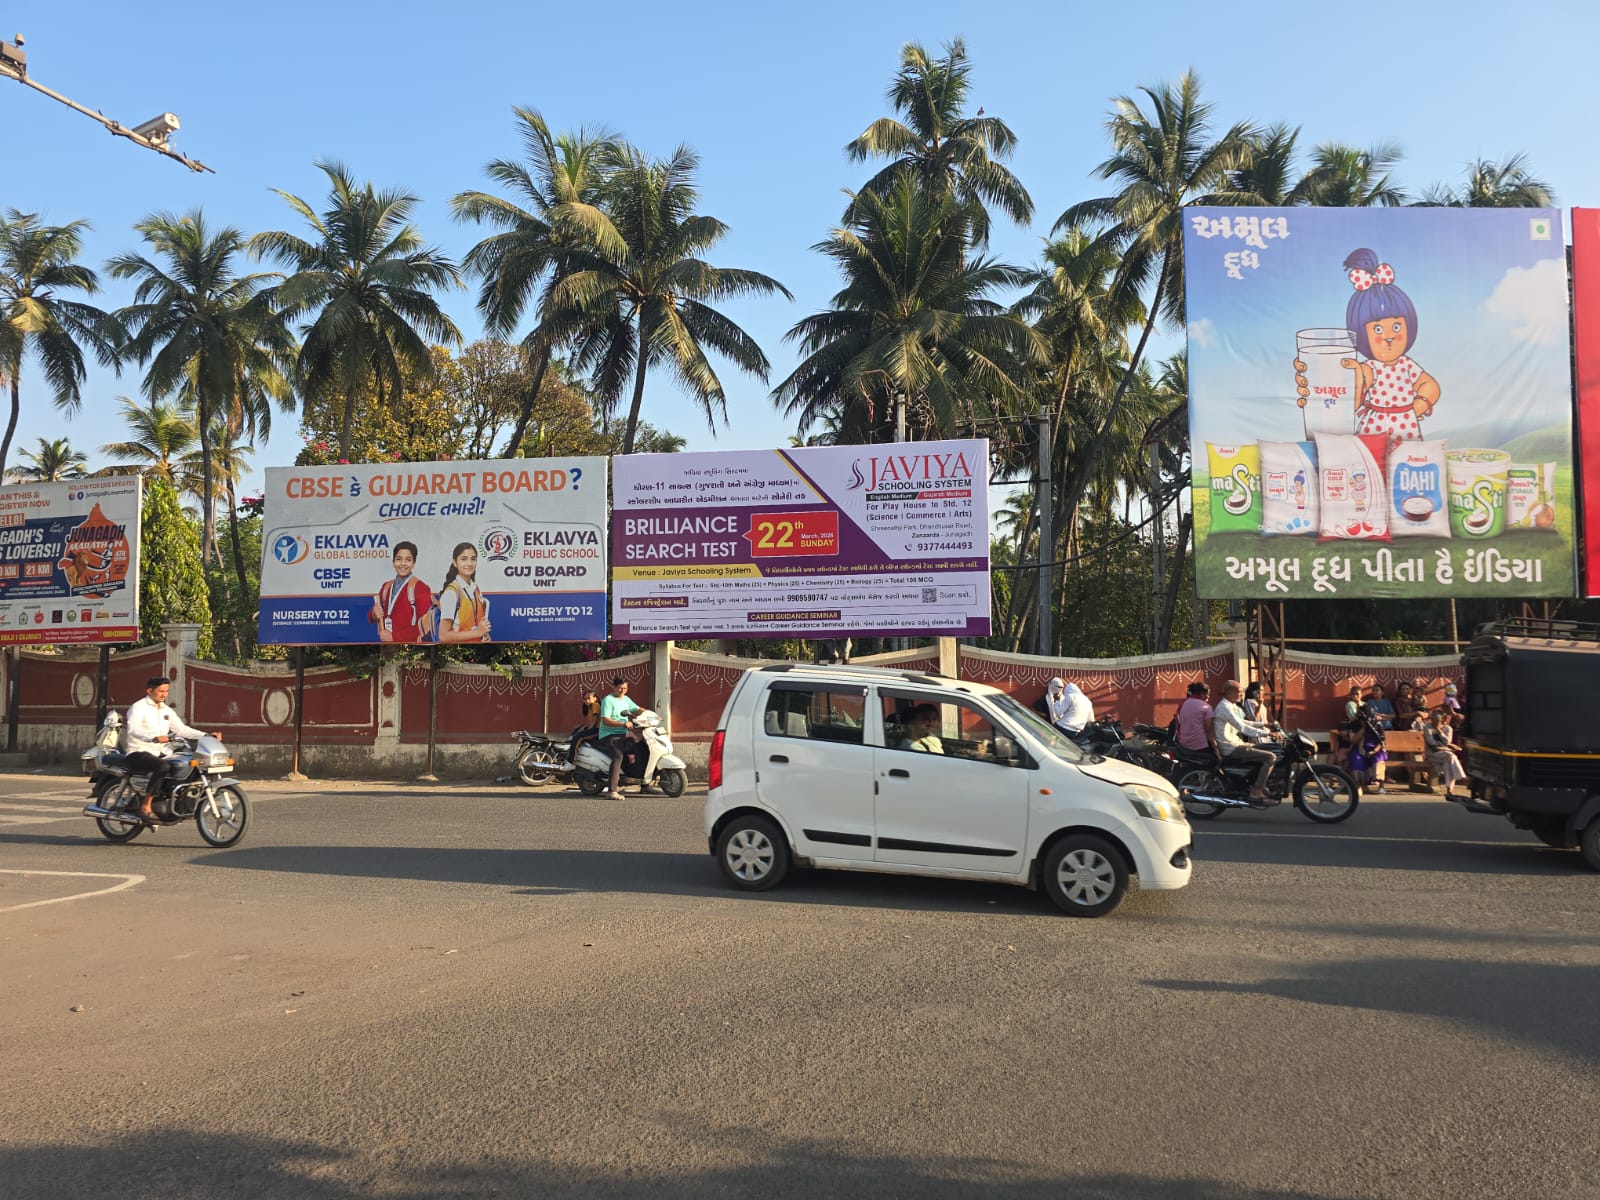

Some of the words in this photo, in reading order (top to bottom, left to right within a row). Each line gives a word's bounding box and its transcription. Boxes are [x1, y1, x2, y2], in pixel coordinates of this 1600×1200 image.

[1191, 215, 1291, 248] અમૂલ
[1223, 250, 1261, 280] દૂધ
[1313, 386, 1347, 398] અમૂલ
[865, 452, 972, 492] JAVIYA
[286, 476, 344, 499] CBSE
[350, 476, 362, 497] કે
[368, 472, 476, 497] GUJARAT
[878, 480, 932, 491] SCHOOLING
[934, 479, 972, 488] SYSTEM
[1400, 468, 1435, 492] DAHI
[30, 500, 51, 508] NOW
[379, 502, 436, 518] CHOICE
[440, 497, 486, 517] તમારી!
[866, 503, 878, 511] For
[882, 502, 899, 511] Play
[866, 513, 898, 522] (Science
[906, 512, 946, 520] Commerce
[625, 516, 737, 536] BRILLIANCE
[0, 528, 44, 545] GADH'S
[66, 525, 127, 542] JUNAGADH
[524, 531, 598, 546] EKLAVYA
[69, 541, 123, 551] MARATHN
[314, 534, 390, 549] EKLAVYA
[800, 539, 834, 548] SUNDAY
[917, 542, 973, 551] 9377444493
[6, 543, 61, 560] LOVERS!!
[314, 551, 350, 560] GLOBAL
[353, 550, 390, 558] SCHOOL
[524, 550, 557, 559] PUBLIC
[560, 548, 599, 558] SCHOOL
[626, 543, 696, 560] SEARCH
[702, 542, 737, 558] TEST
[26, 565, 36, 576] 21
[38, 564, 50, 575] KM
[314, 568, 350, 580] CBSE
[504, 566, 531, 577] GUJ
[535, 566, 587, 576] BOARD
[662, 568, 686, 576] Javiya
[687, 567, 723, 576] Schooling
[725, 566, 752, 576] System
[1226, 555, 1300, 592] અમૂલ
[1311, 556, 1351, 592] દૂધ
[1361, 548, 1424, 582] પીતા
[1435, 548, 1454, 585] હૈ
[272, 610, 321, 620] NURSERY
[323, 610, 338, 619] TO
[339, 610, 350, 619] 12
[510, 607, 564, 617] NURSERY
[565, 607, 580, 616] TO
[582, 607, 592, 615] 12
